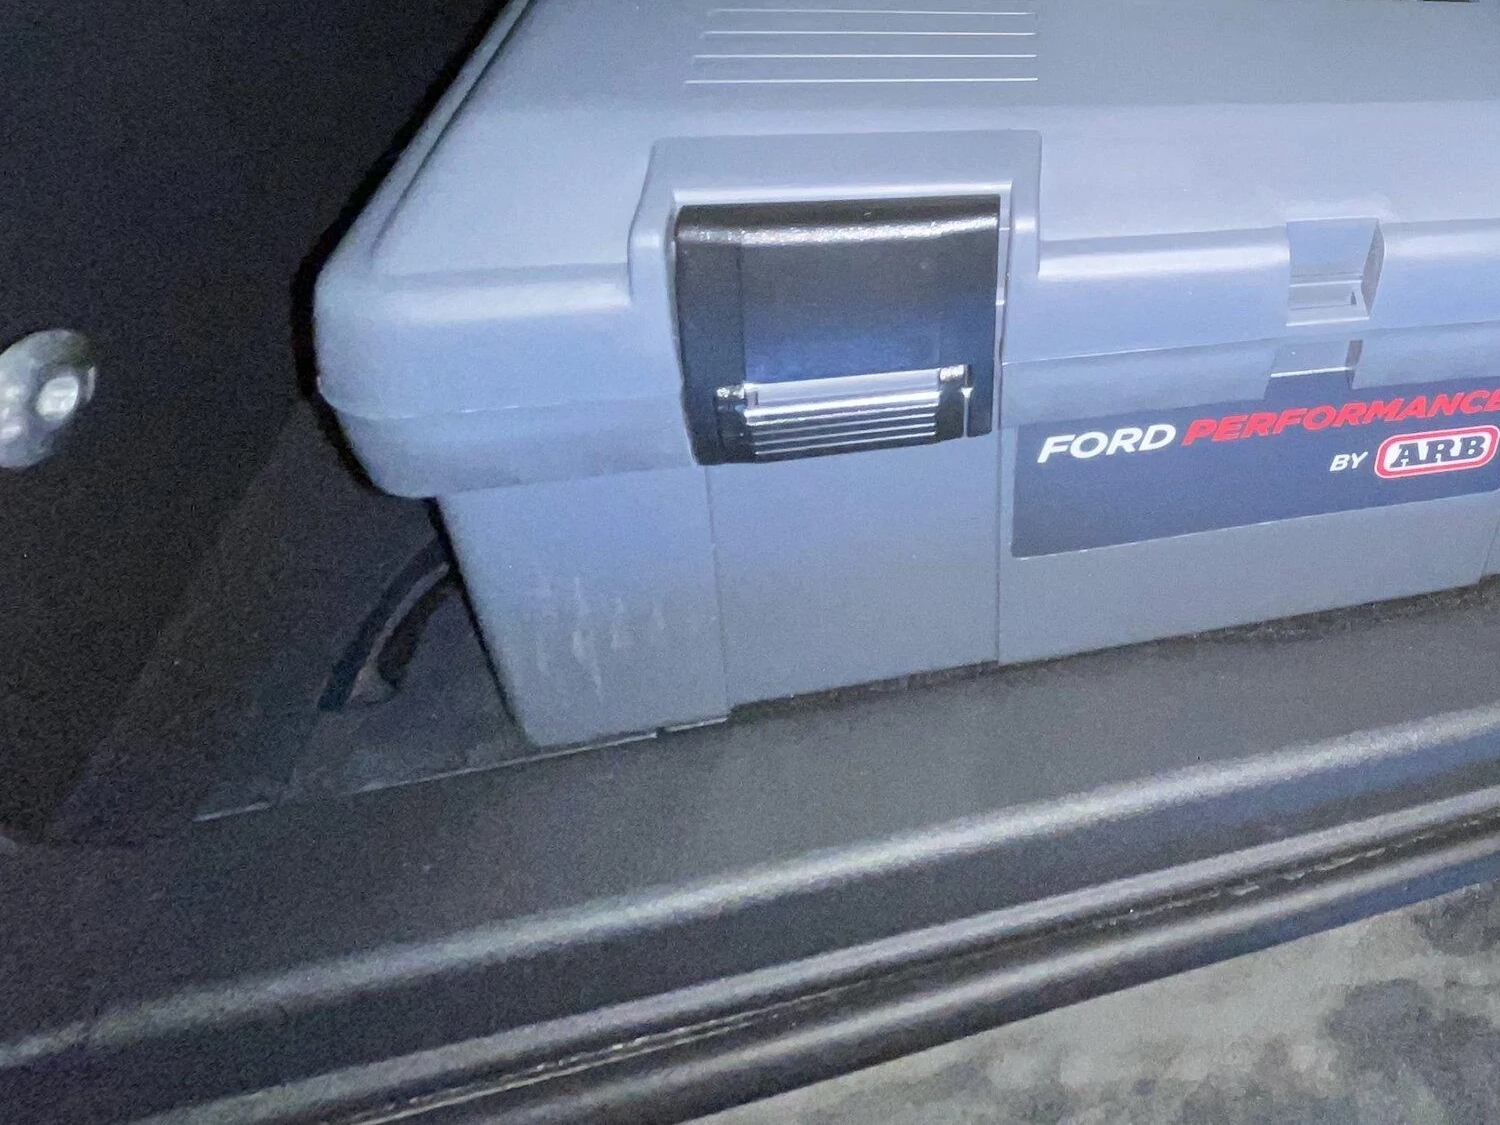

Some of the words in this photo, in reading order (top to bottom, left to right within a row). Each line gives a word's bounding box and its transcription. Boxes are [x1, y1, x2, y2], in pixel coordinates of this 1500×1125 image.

[1037, 423, 1177, 463] FORD
[1329, 451, 1369, 473] BY
[1390, 436, 1490, 469] ARB
